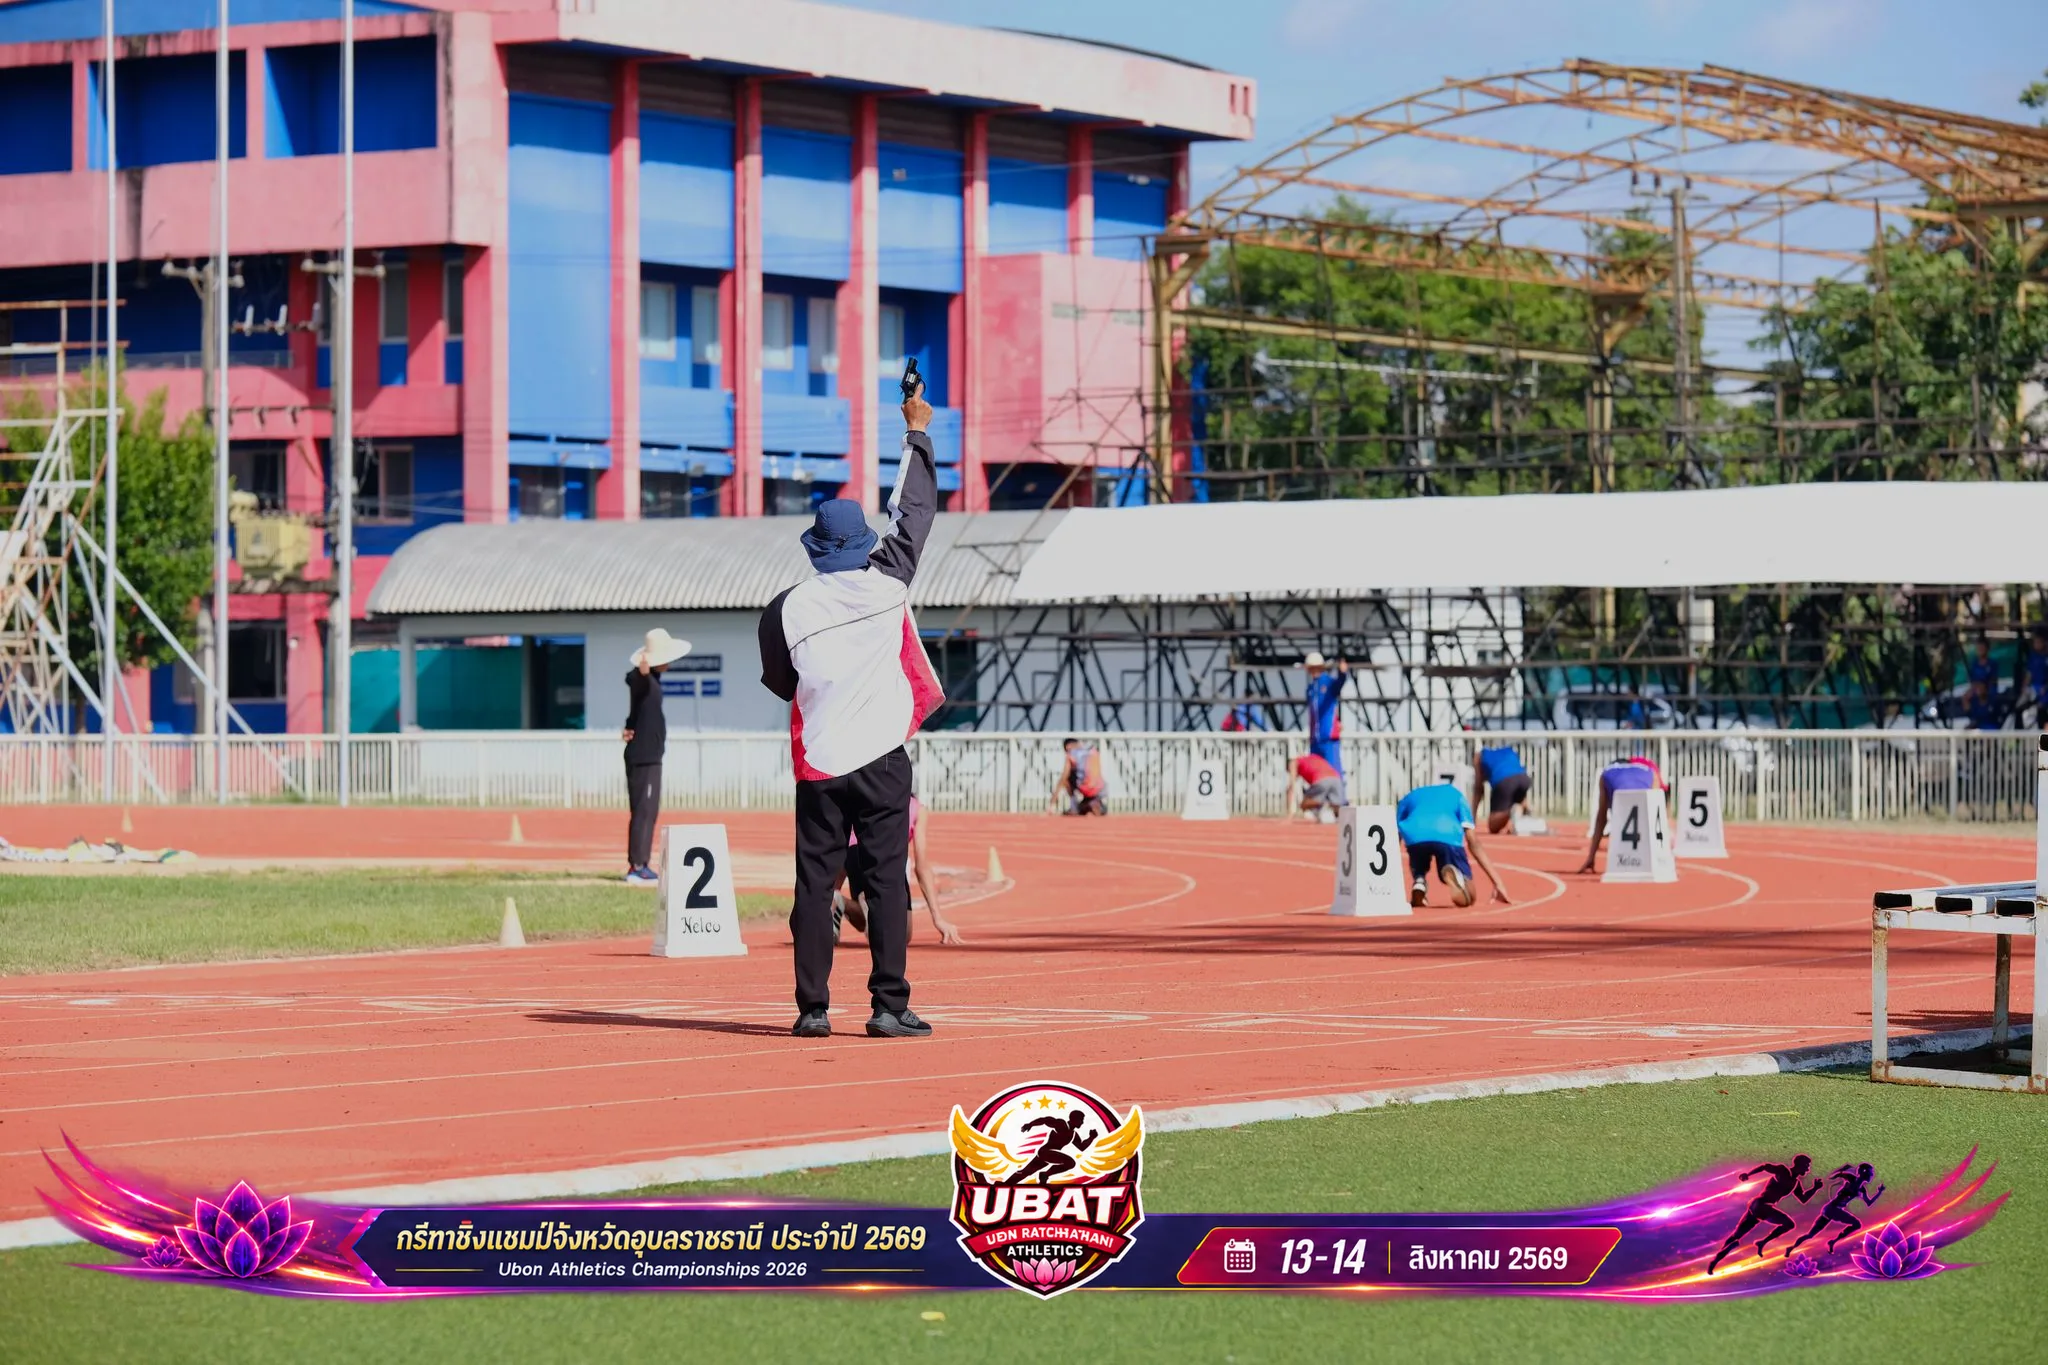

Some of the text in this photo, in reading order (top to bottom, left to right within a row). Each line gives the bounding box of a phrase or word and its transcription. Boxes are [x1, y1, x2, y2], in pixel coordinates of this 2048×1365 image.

[1199, 770, 1212, 796] 8
[1621, 805, 1641, 850] 4
[1655, 805, 1663, 848] 4
[1689, 790, 1708, 827] 5
[1341, 824, 1352, 877] 3
[1368, 824, 1388, 876] 3
[683, 846, 718, 909] 2
